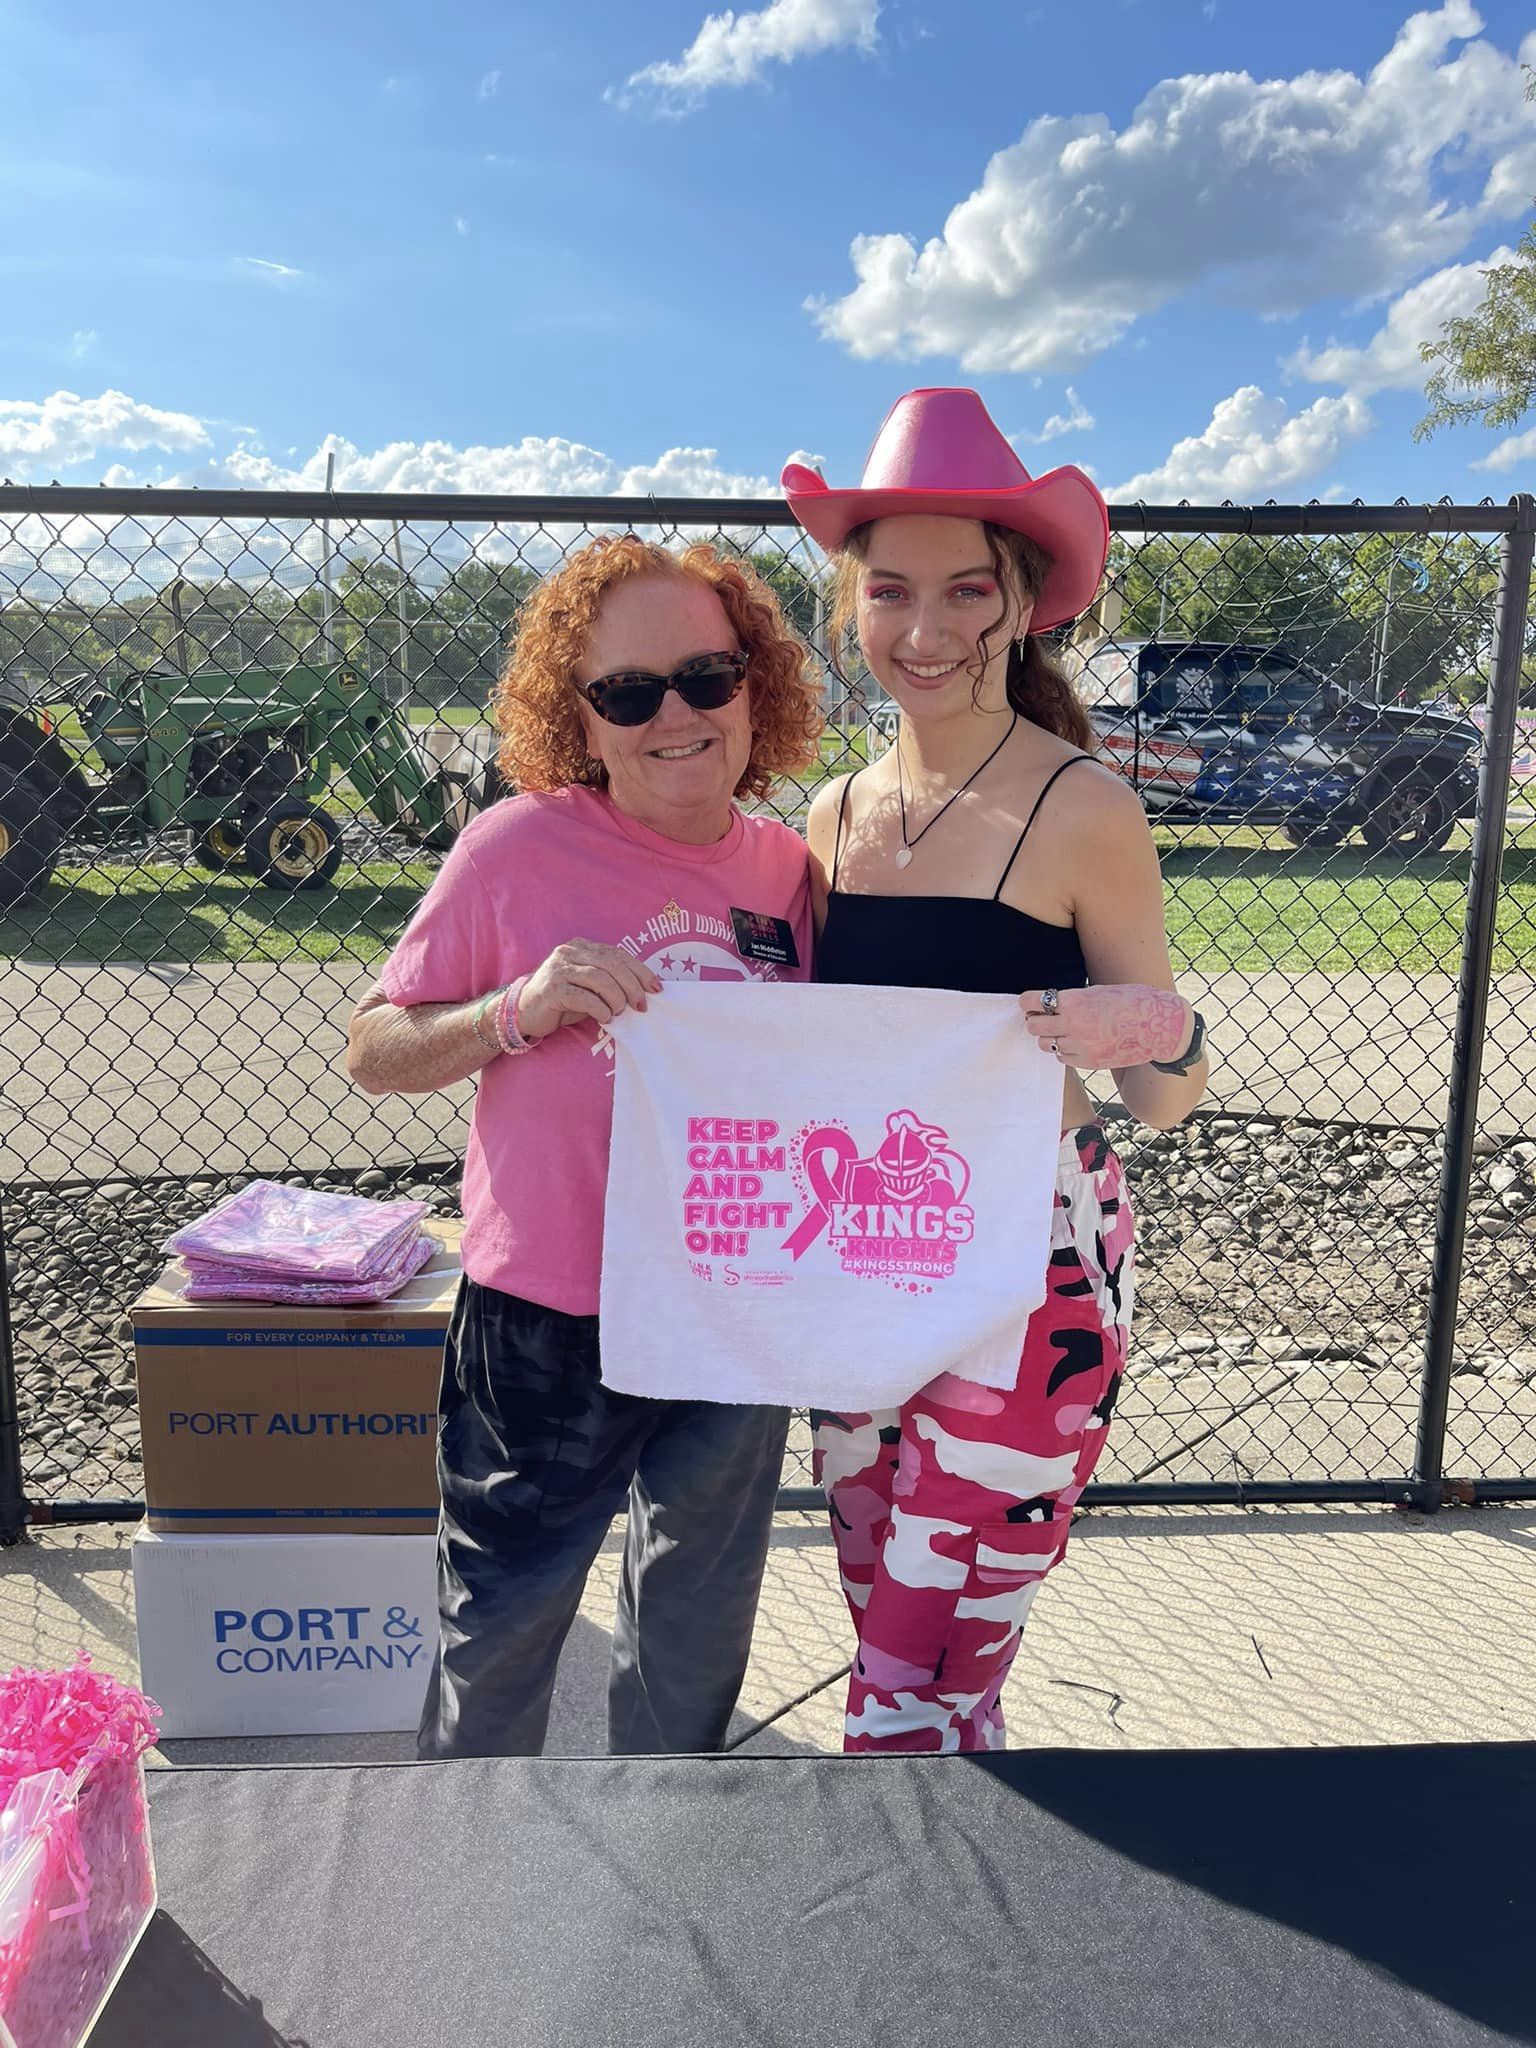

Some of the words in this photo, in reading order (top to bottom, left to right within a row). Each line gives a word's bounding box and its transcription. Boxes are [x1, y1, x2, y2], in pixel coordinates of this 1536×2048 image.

[646, 909, 690, 942] HARD
[688, 1117, 779, 1143] KEEP
[687, 1145, 785, 1171] CALM
[683, 1174, 763, 1199] AND
[684, 1202, 792, 1228] FIGHT
[830, 1201, 975, 1243] KINGS
[685, 1230, 749, 1256] ON!
[848, 1238, 958, 1263] KNIGHTS
[844, 1260, 953, 1274] #KINGSSTRONG
[227, 1333, 251, 1342] FOR
[255, 1333, 295, 1342] EVERY
[298, 1333, 356, 1342] COMPANY
[360, 1334, 369, 1342] &
[372, 1333, 406, 1342] TEAM
[169, 1412, 260, 1435] PORT
[214, 1607, 370, 1643] PORT
[382, 1606, 424, 1639] &
[216, 1644, 422, 1674] COMPANY
